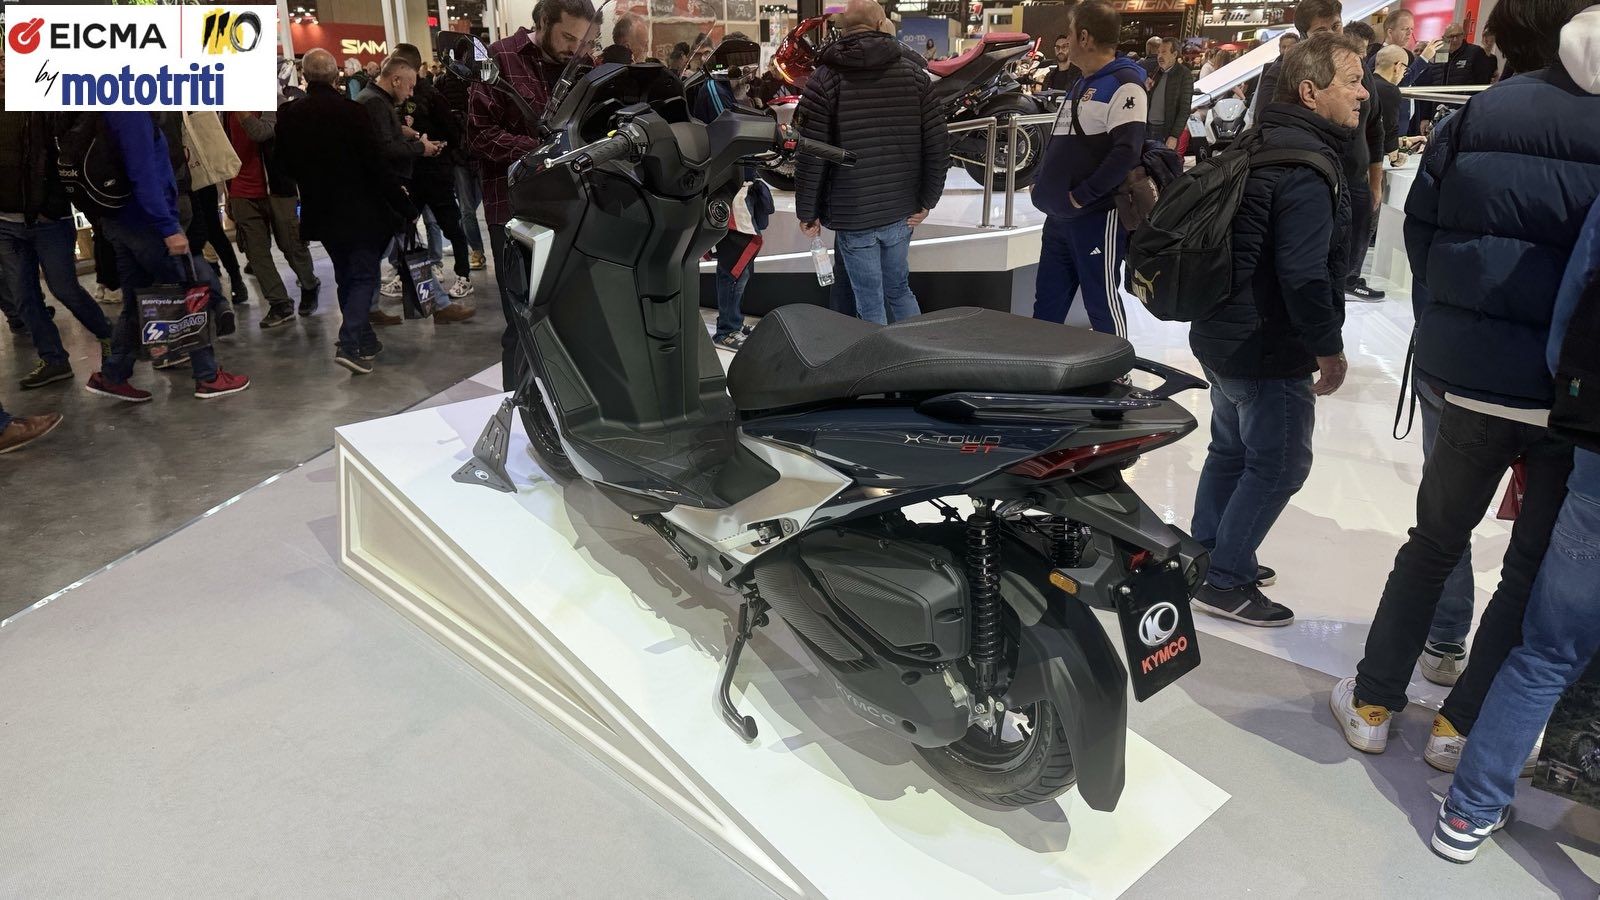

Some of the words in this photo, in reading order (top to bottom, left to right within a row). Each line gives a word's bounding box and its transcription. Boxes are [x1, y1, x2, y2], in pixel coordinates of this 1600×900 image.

[341, 39, 388, 55] SWM
[960, 443, 999, 454] ST
[1140, 635, 1188, 675] KYMCO
[1450, 817, 1469, 829] NIKE
